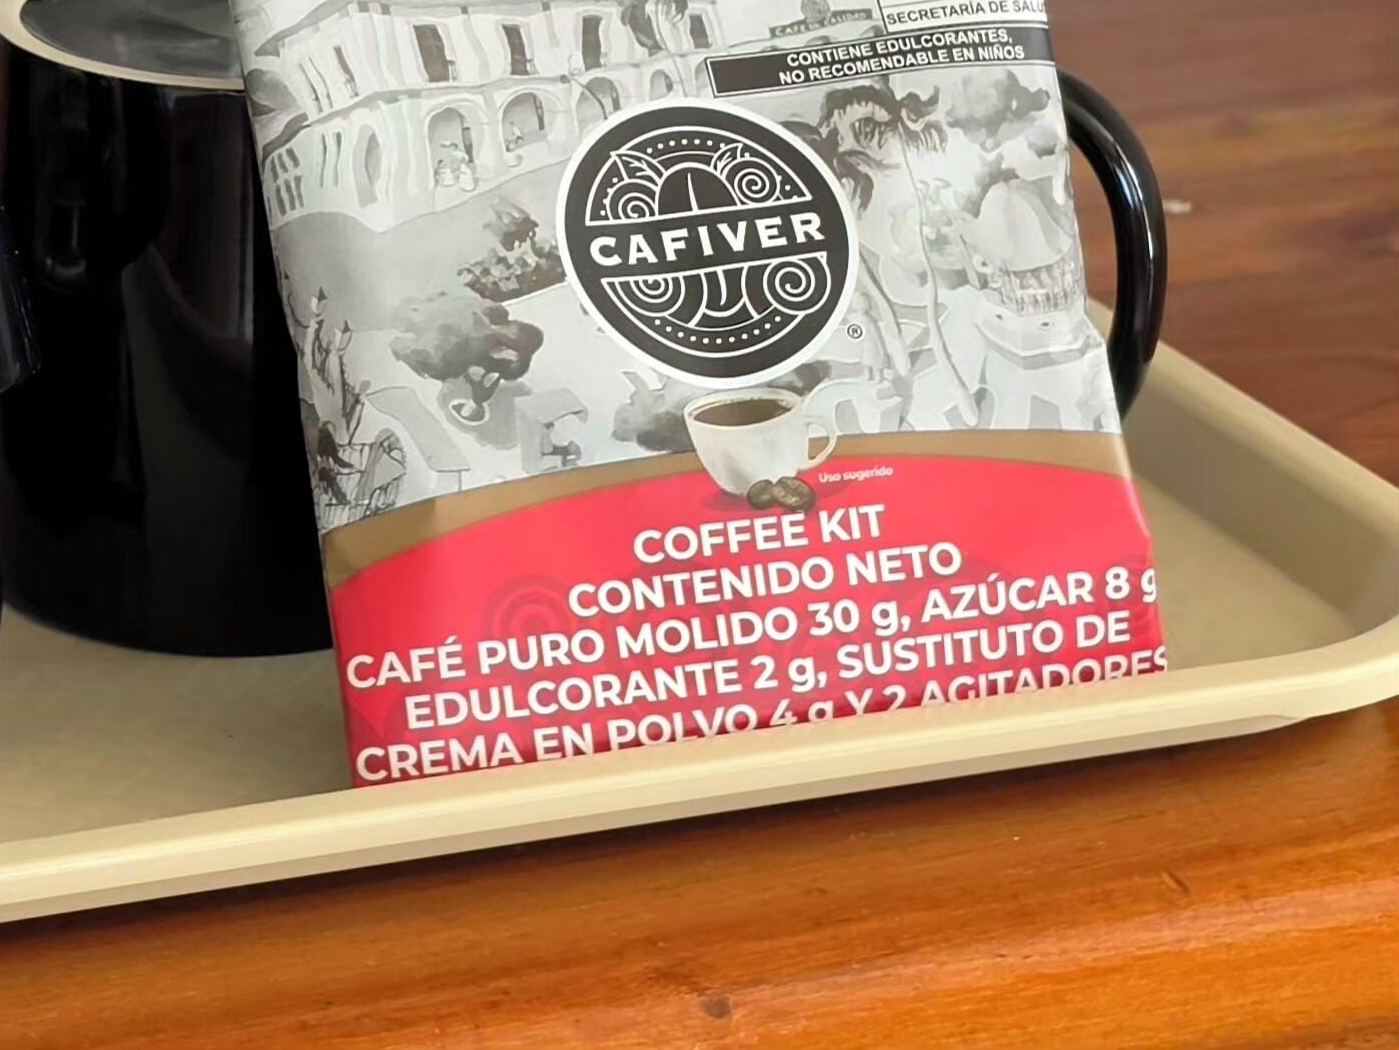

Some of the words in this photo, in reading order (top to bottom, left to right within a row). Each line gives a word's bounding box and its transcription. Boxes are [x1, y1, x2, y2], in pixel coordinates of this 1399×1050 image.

[886, 0, 987, 25] SECRETARÍA
[988, 0, 1010, 14] DE
[779, 70, 805, 86] NO
[809, 52, 951, 81] RECOMENDABLE
[953, 48, 976, 63] EN
[979, 43, 1026, 61] NIÑOS
[786, 44, 873, 68] CONTIENE
[876, 28, 1014, 55] EDULCORANTES,
[589, 211, 827, 268] CAFIVER
[843, 465, 894, 481] sugerido
[633, 513, 809, 564] COFFEE
[818, 503, 886, 543] KIT
[568, 556, 835, 618] CONTENIDO
[846, 541, 962, 586] NETO
[346, 636, 466, 689] CAFÉ
[477, 628, 605, 675] PURO
[616, 607, 798, 659] MOLIDO
[808, 599, 860, 637] 30
[870, 598, 911, 637] g,
[921, 570, 1094, 623] AZÚCAR
[1105, 566, 1131, 601] 8
[405, 658, 743, 730] EDULCORANTE
[750, 656, 778, 690] 2
[787, 656, 828, 694] g,
[835, 620, 1064, 680] SUSTITUTO
[1076, 610, 1131, 648] DE
[356, 733, 523, 782] CREMA
[532, 722, 593, 762] EN
[607, 703, 759, 751] POLVO
[769, 698, 798, 727] 4
[845, 687, 874, 717] Y
[882, 684, 908, 712] 2
[921, 644, 1169, 707] AGITADORES
